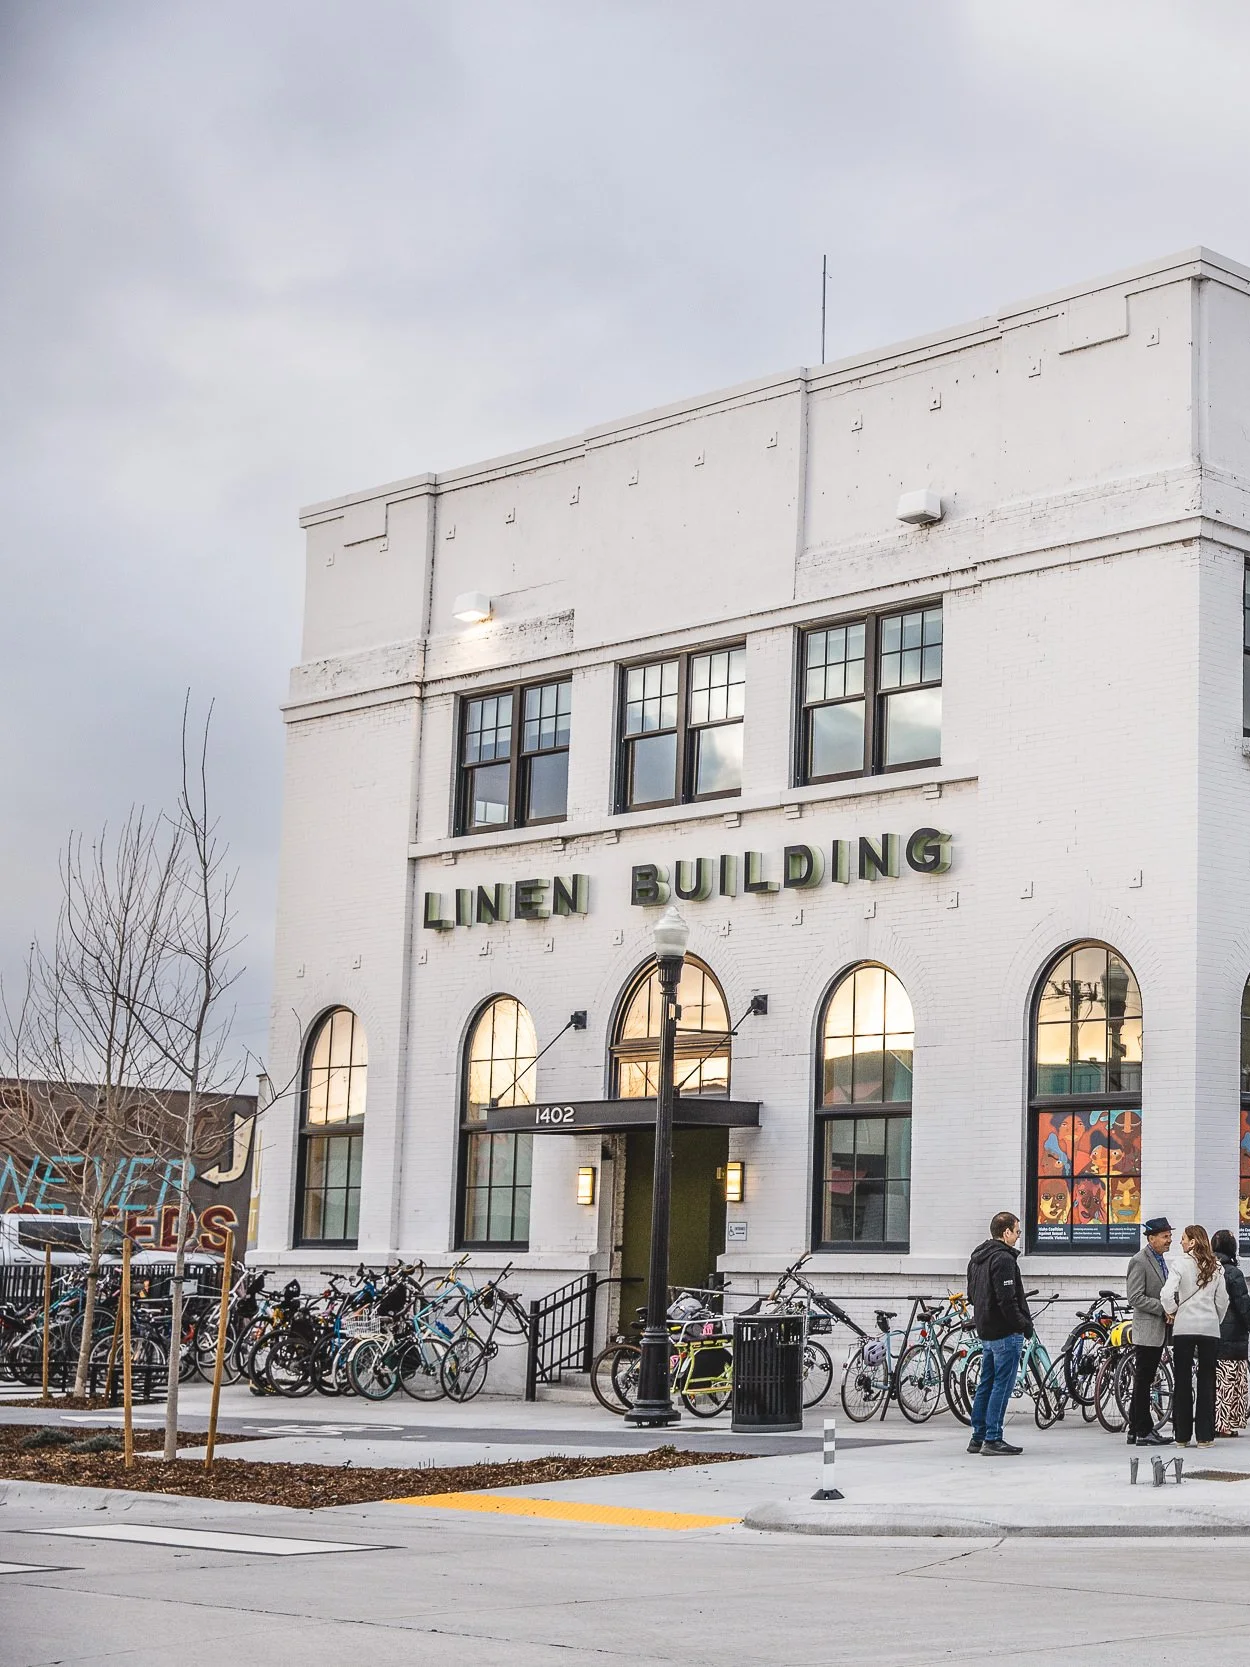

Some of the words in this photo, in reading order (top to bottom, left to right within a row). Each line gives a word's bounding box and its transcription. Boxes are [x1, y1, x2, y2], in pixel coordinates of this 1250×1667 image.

[423, 873, 589, 930] LINEN
[631, 827, 953, 907] BUILDING
[535, 1106, 575, 1124] 1402
[0, 1155, 197, 1212] NEVER
